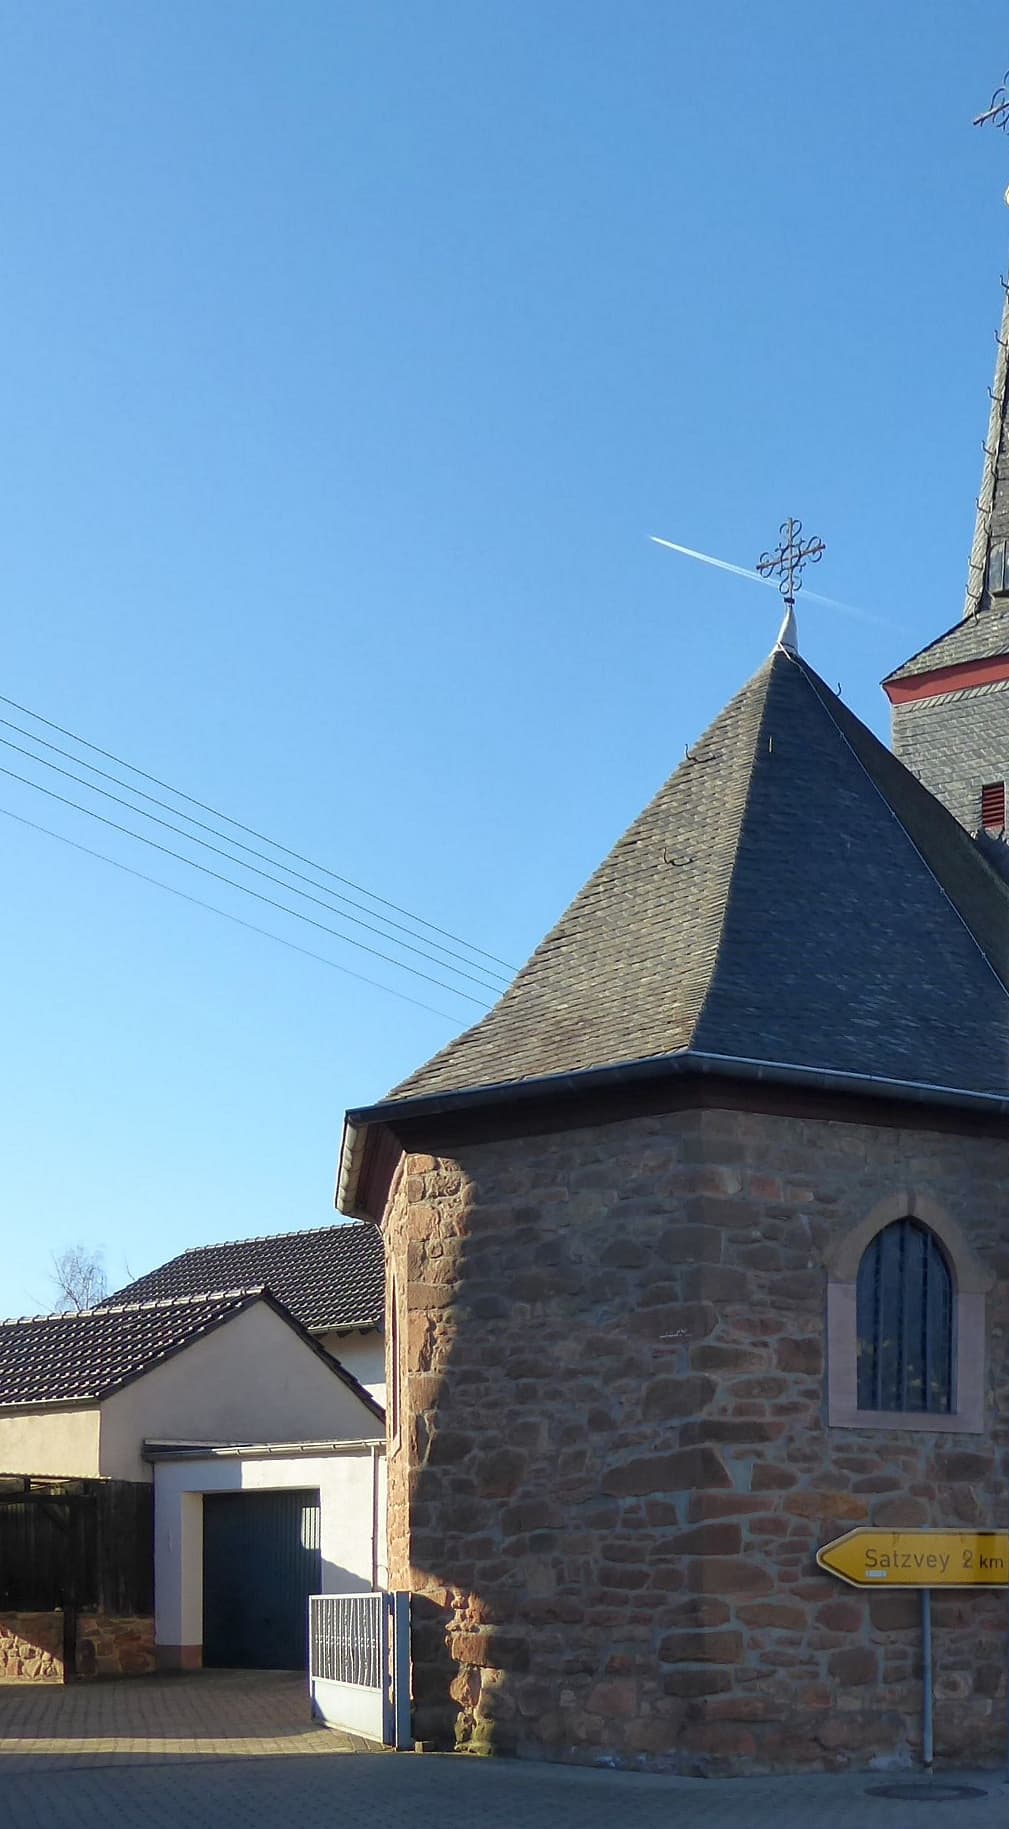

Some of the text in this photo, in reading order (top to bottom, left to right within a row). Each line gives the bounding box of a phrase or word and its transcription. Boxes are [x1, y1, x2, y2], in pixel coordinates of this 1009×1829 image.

[864, 1548, 1004, 1573] Satzvey 2 km
